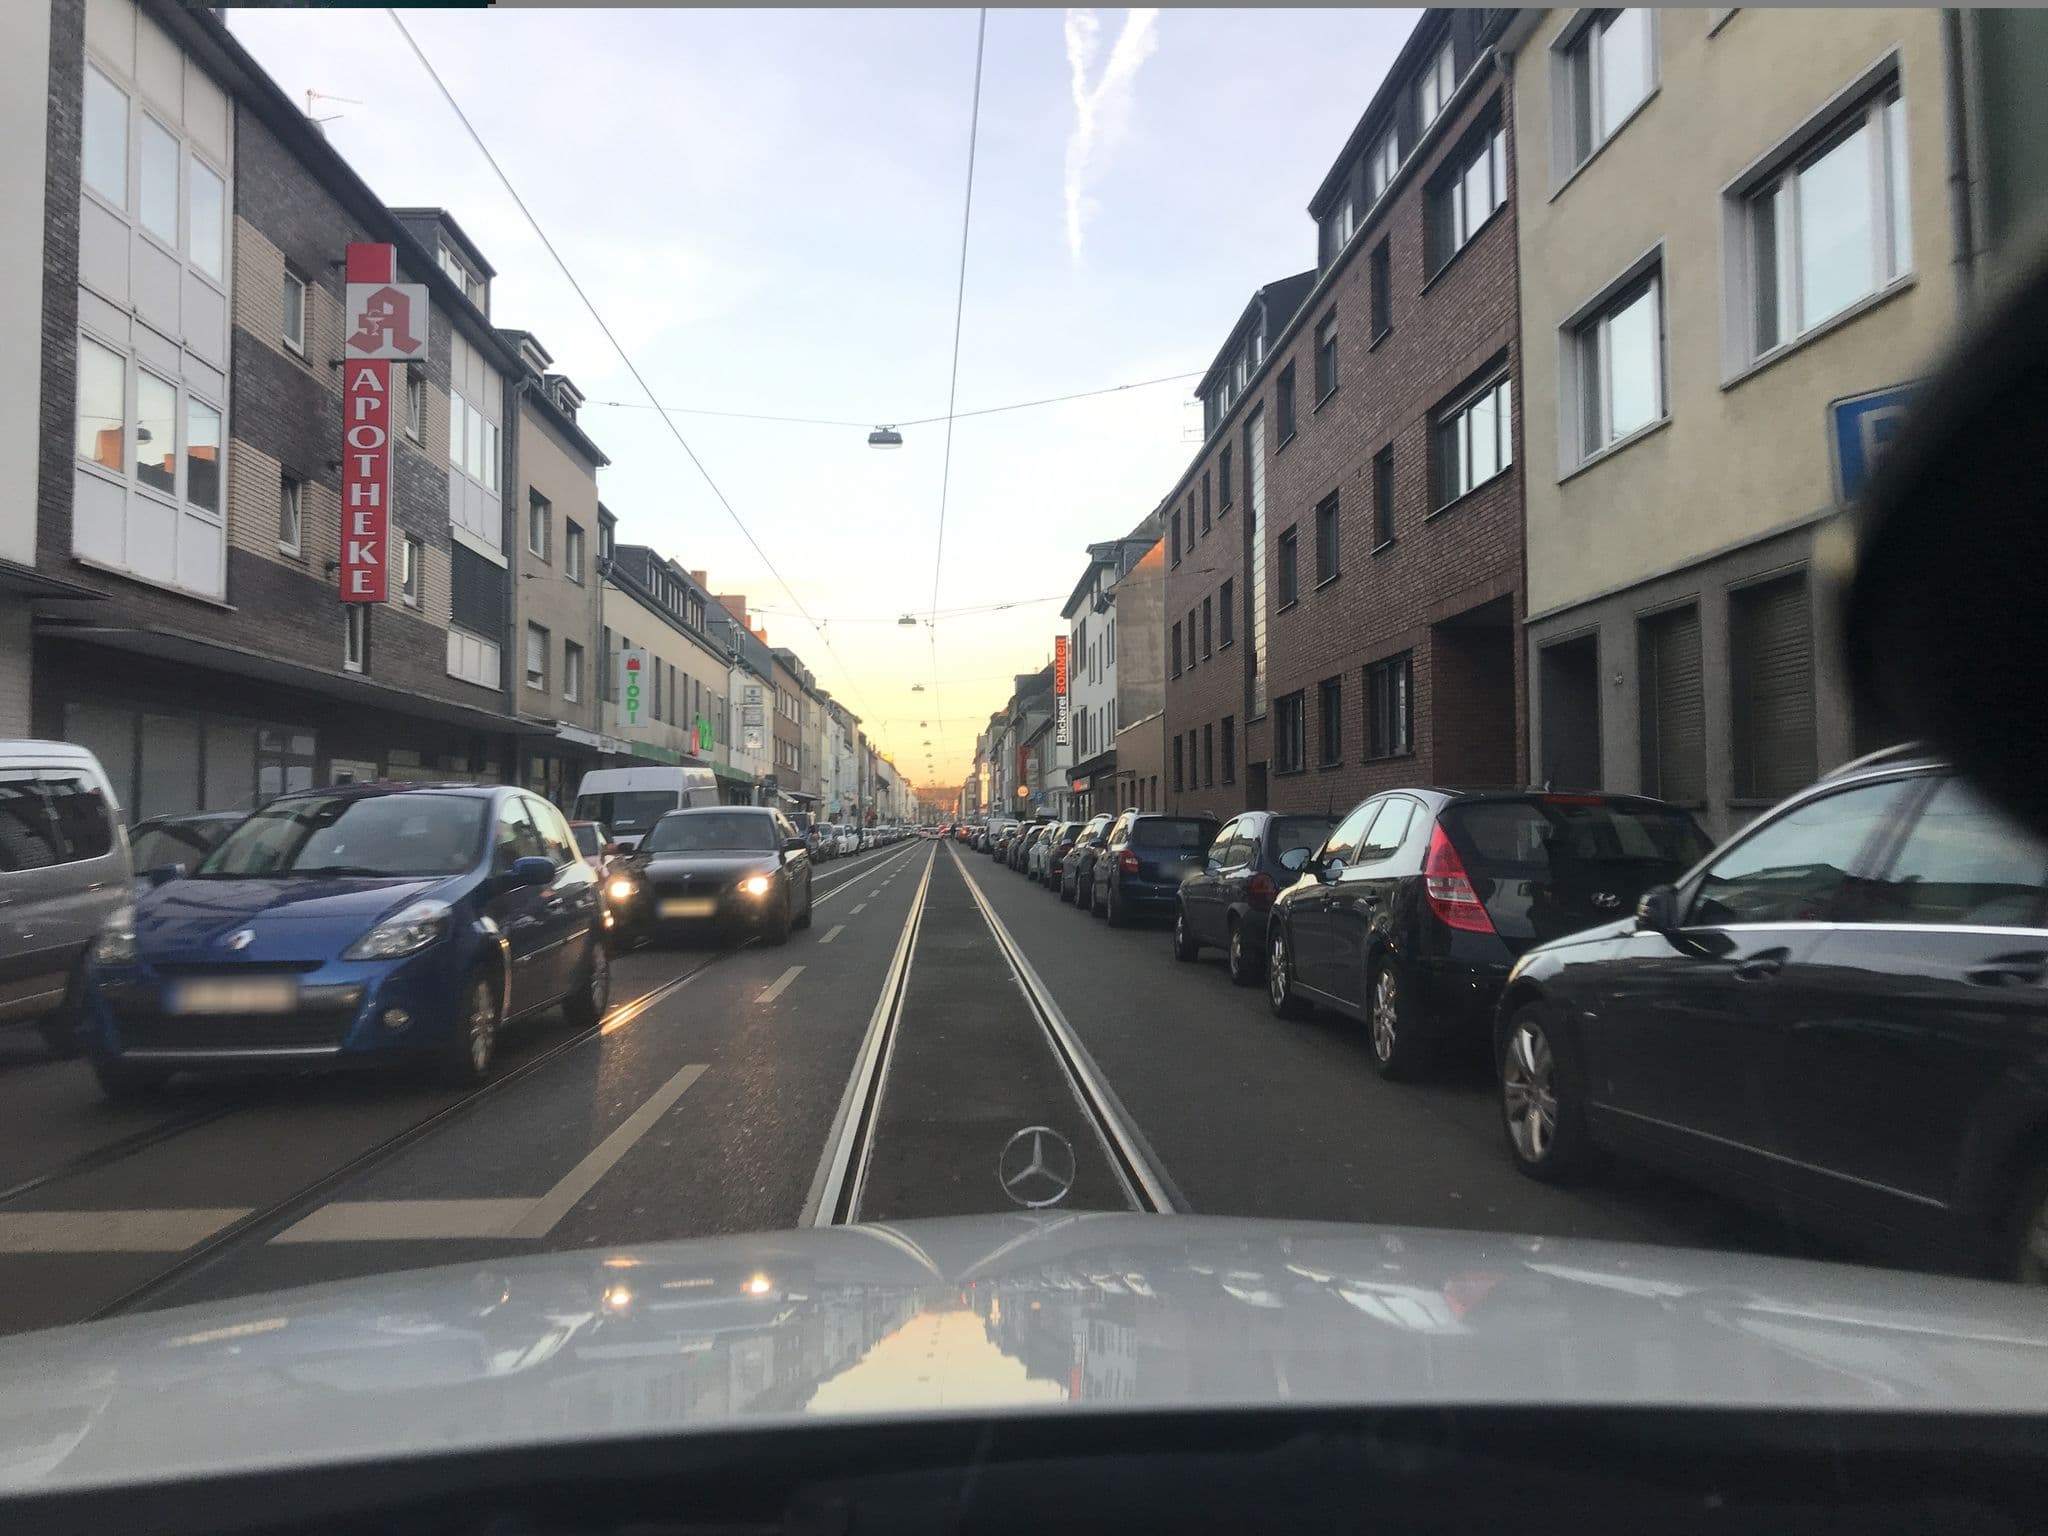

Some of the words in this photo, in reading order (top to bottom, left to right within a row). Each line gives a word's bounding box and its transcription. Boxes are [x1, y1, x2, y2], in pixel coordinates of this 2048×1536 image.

[346, 368, 386, 595] APOTHEKE
[626, 671, 641, 725] TODI
[1056, 696, 1067, 743] Bäckerei
